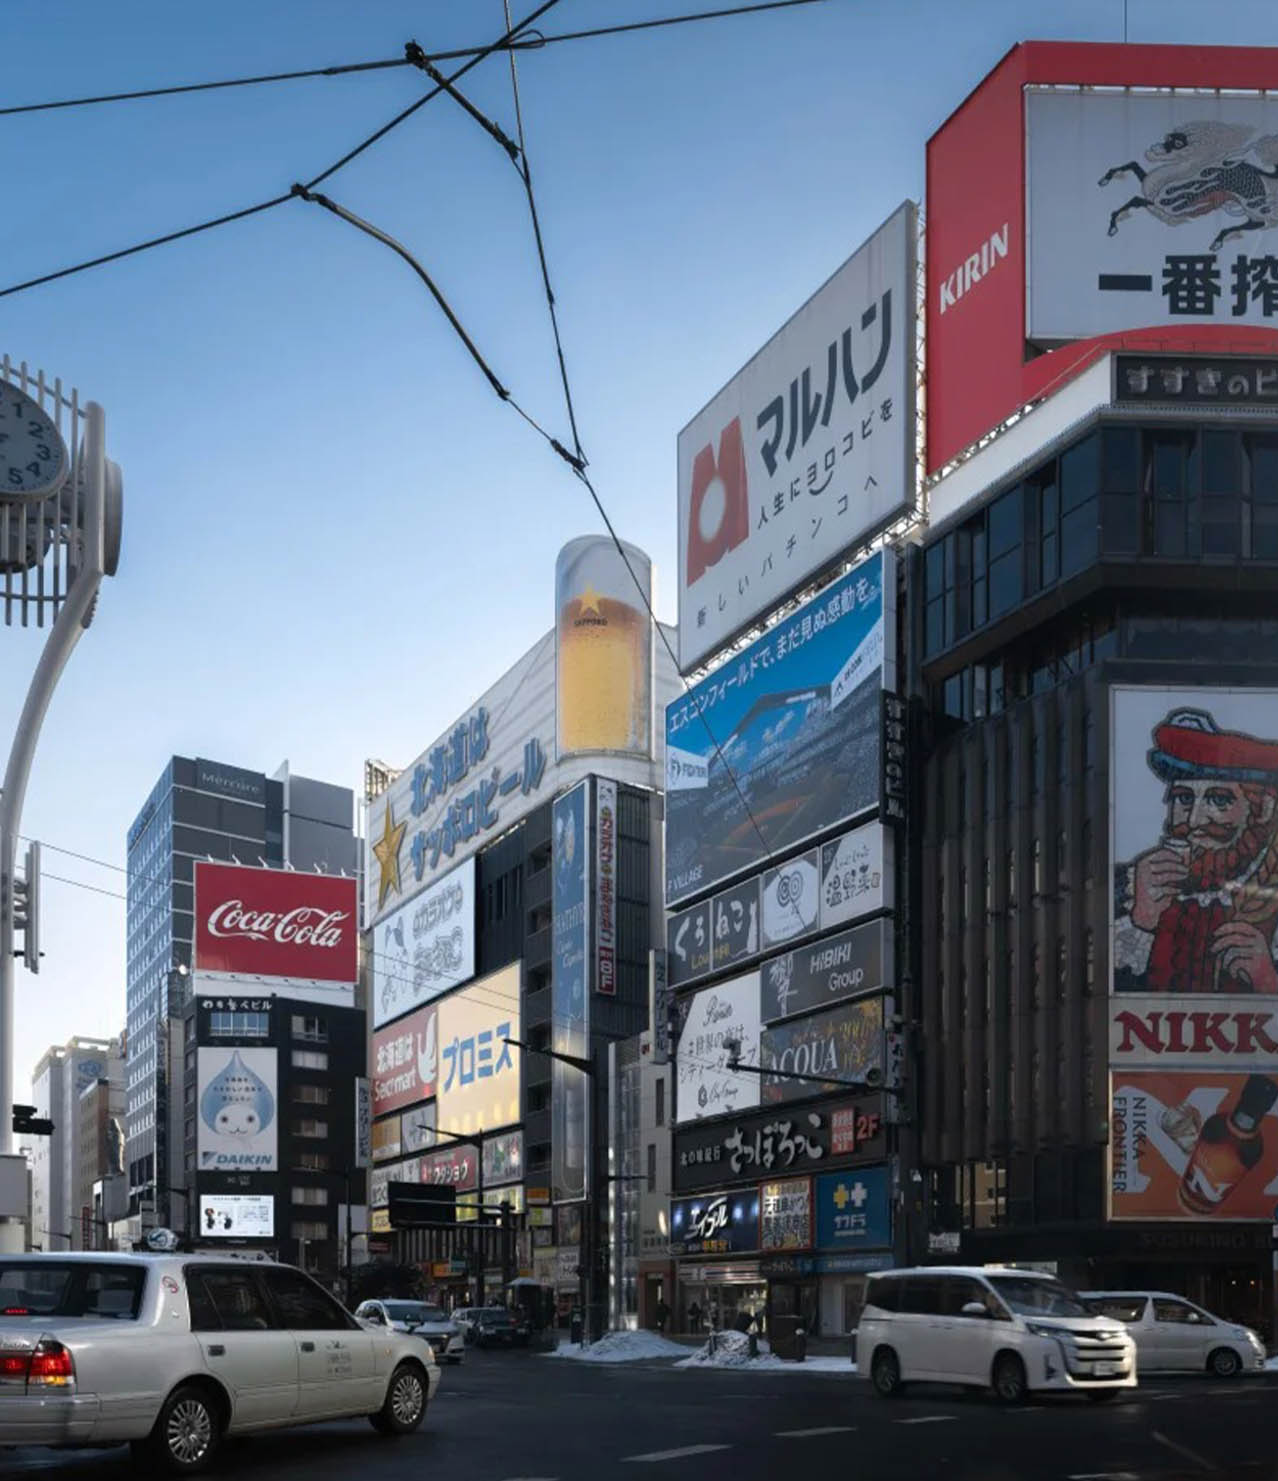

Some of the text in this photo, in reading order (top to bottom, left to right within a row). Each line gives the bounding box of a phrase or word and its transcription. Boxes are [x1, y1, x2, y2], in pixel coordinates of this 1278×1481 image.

[939, 222, 1010, 315] KIRIN
[756, 288, 893, 479] マルハン
[12, 402, 23, 419] 1
[28, 421, 43, 439] 2
[25, 461, 40, 477] 4
[36, 443, 51, 461] 3
[757, 398, 894, 530] 人生にヨロコビを
[8, 467, 23, 485] 5
[670, 576, 875, 734] エスコンフィールドで、まだ見ぬ感動を。
[410, 736, 547, 882] サッポロビール
[207, 900, 351, 947] Coca-Cola
[675, 900, 743, 962] くろねこ
[828, 968, 864, 992] Group
[442, 1021, 513, 1095] プロミス
[766, 1038, 838, 1086] ACQUA
[856, 1114, 880, 1141] 2F
[1113, 1097, 1128, 1192] FRONTIER
[1133, 1097, 1147, 1160] NIKKA
[216, 1154, 273, 1166] DAIKIN
[684, 1197, 728, 1240] エイブル
